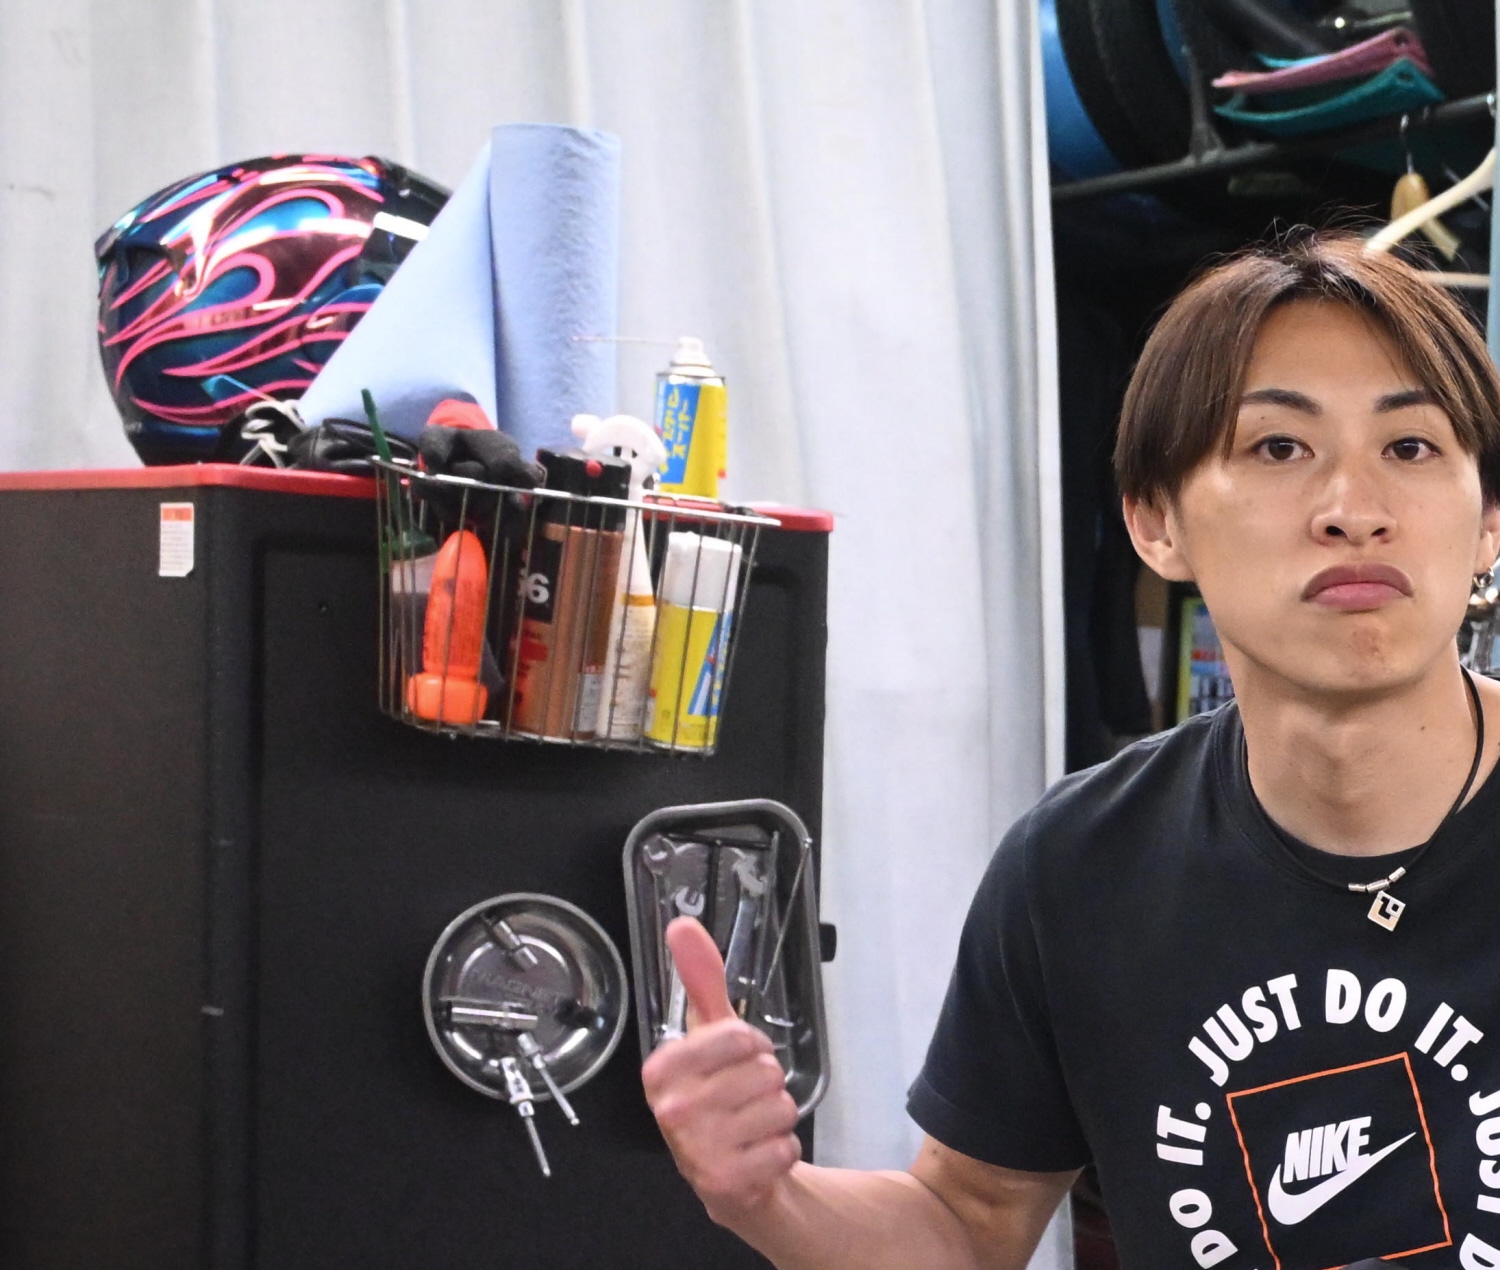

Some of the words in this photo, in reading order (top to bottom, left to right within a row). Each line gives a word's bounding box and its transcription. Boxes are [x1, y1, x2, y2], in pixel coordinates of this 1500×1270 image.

[1188, 973, 1302, 1087] JUST
[1325, 969, 1407, 1032] DO
[1414, 1001, 1484, 1082] IT.
[1156, 1102, 1212, 1166] IT.
[1282, 1115, 1372, 1184] NIKE
[1169, 1188, 1239, 1270] DO
